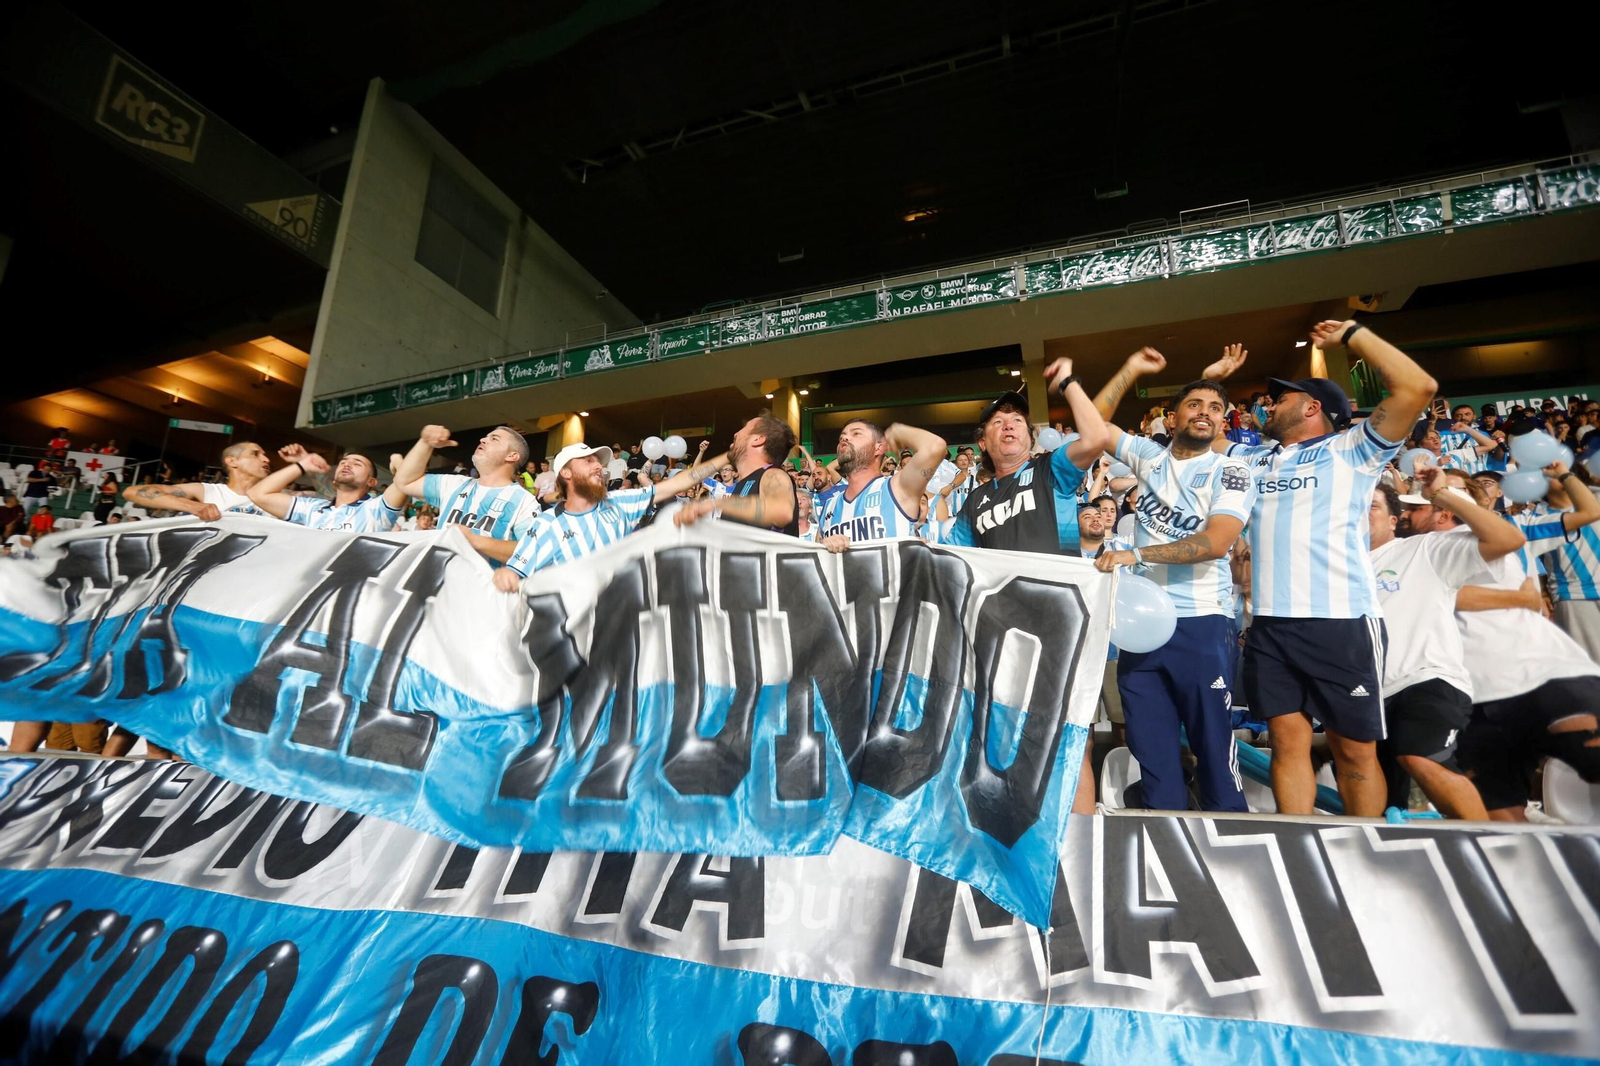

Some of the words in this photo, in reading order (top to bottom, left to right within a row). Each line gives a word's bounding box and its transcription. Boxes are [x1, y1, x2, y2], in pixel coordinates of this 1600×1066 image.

[111, 82, 191, 144] RG3
[280, 207, 308, 239] 90
[940, 279, 963, 289] BMW
[940, 283, 993, 297] MOTORRAD
[904, 301, 946, 315] RAFAEL
[643, 338, 688, 357] rquero
[532, 359, 572, 379] Barqro
[1139, 389, 1147, 398] 2
[1257, 475, 1319, 494] tsson
[976, 488, 1037, 535] RCA
[1135, 491, 1204, 531] dueño
[1156, 523, 1194, 540] pasió
[222, 535, 455, 771] AL
[499, 540, 1091, 850] MUNDO
